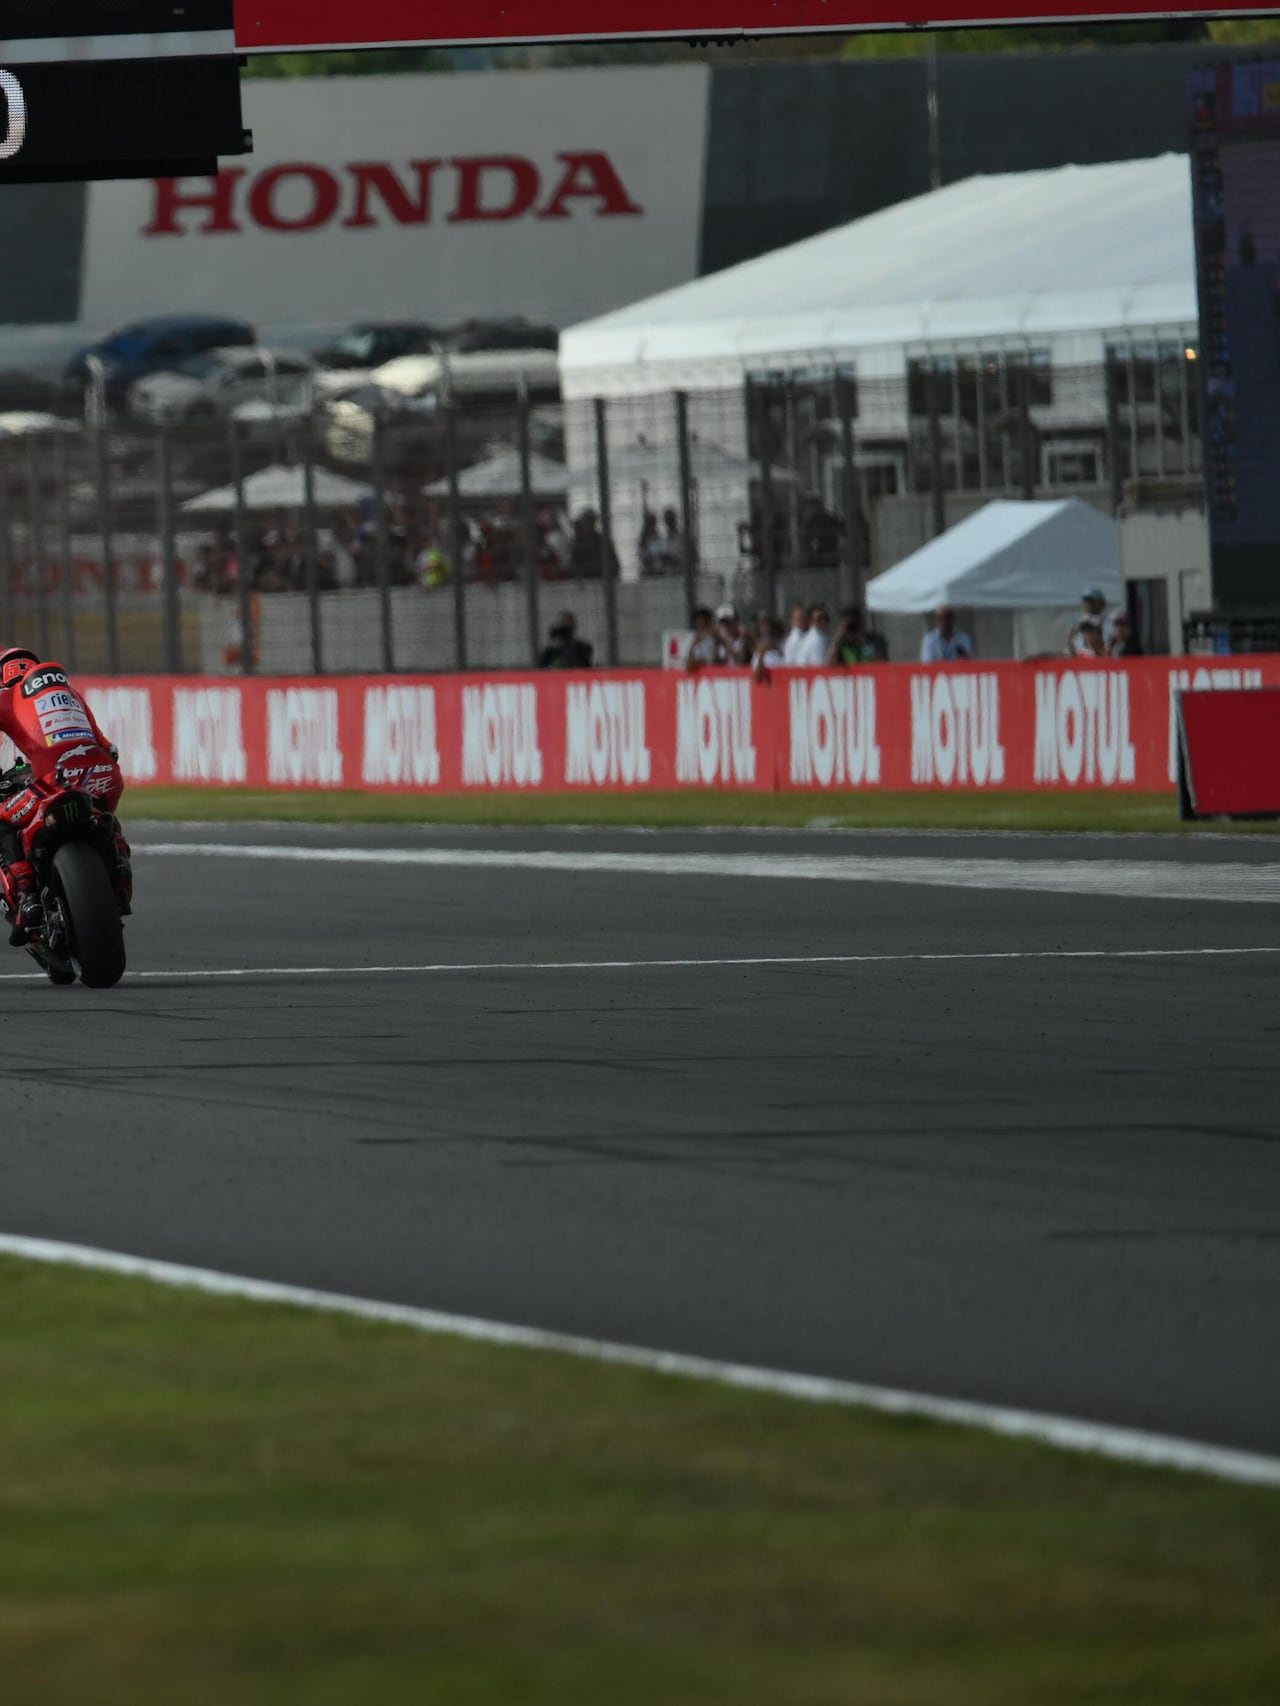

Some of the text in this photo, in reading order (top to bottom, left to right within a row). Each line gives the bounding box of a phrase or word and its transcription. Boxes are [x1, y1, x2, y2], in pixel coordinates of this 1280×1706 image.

[142, 150, 643, 239] HONDA
[3, 658, 36, 684] 63
[462, 684, 543, 785] MOTUL
[565, 681, 651, 785] MOTUL
[676, 677, 757, 784] MOTUL
[789, 675, 881, 785] MOTUL
[910, 674, 1005, 785] MOTUL
[1034, 671, 1136, 784] MOTUL
